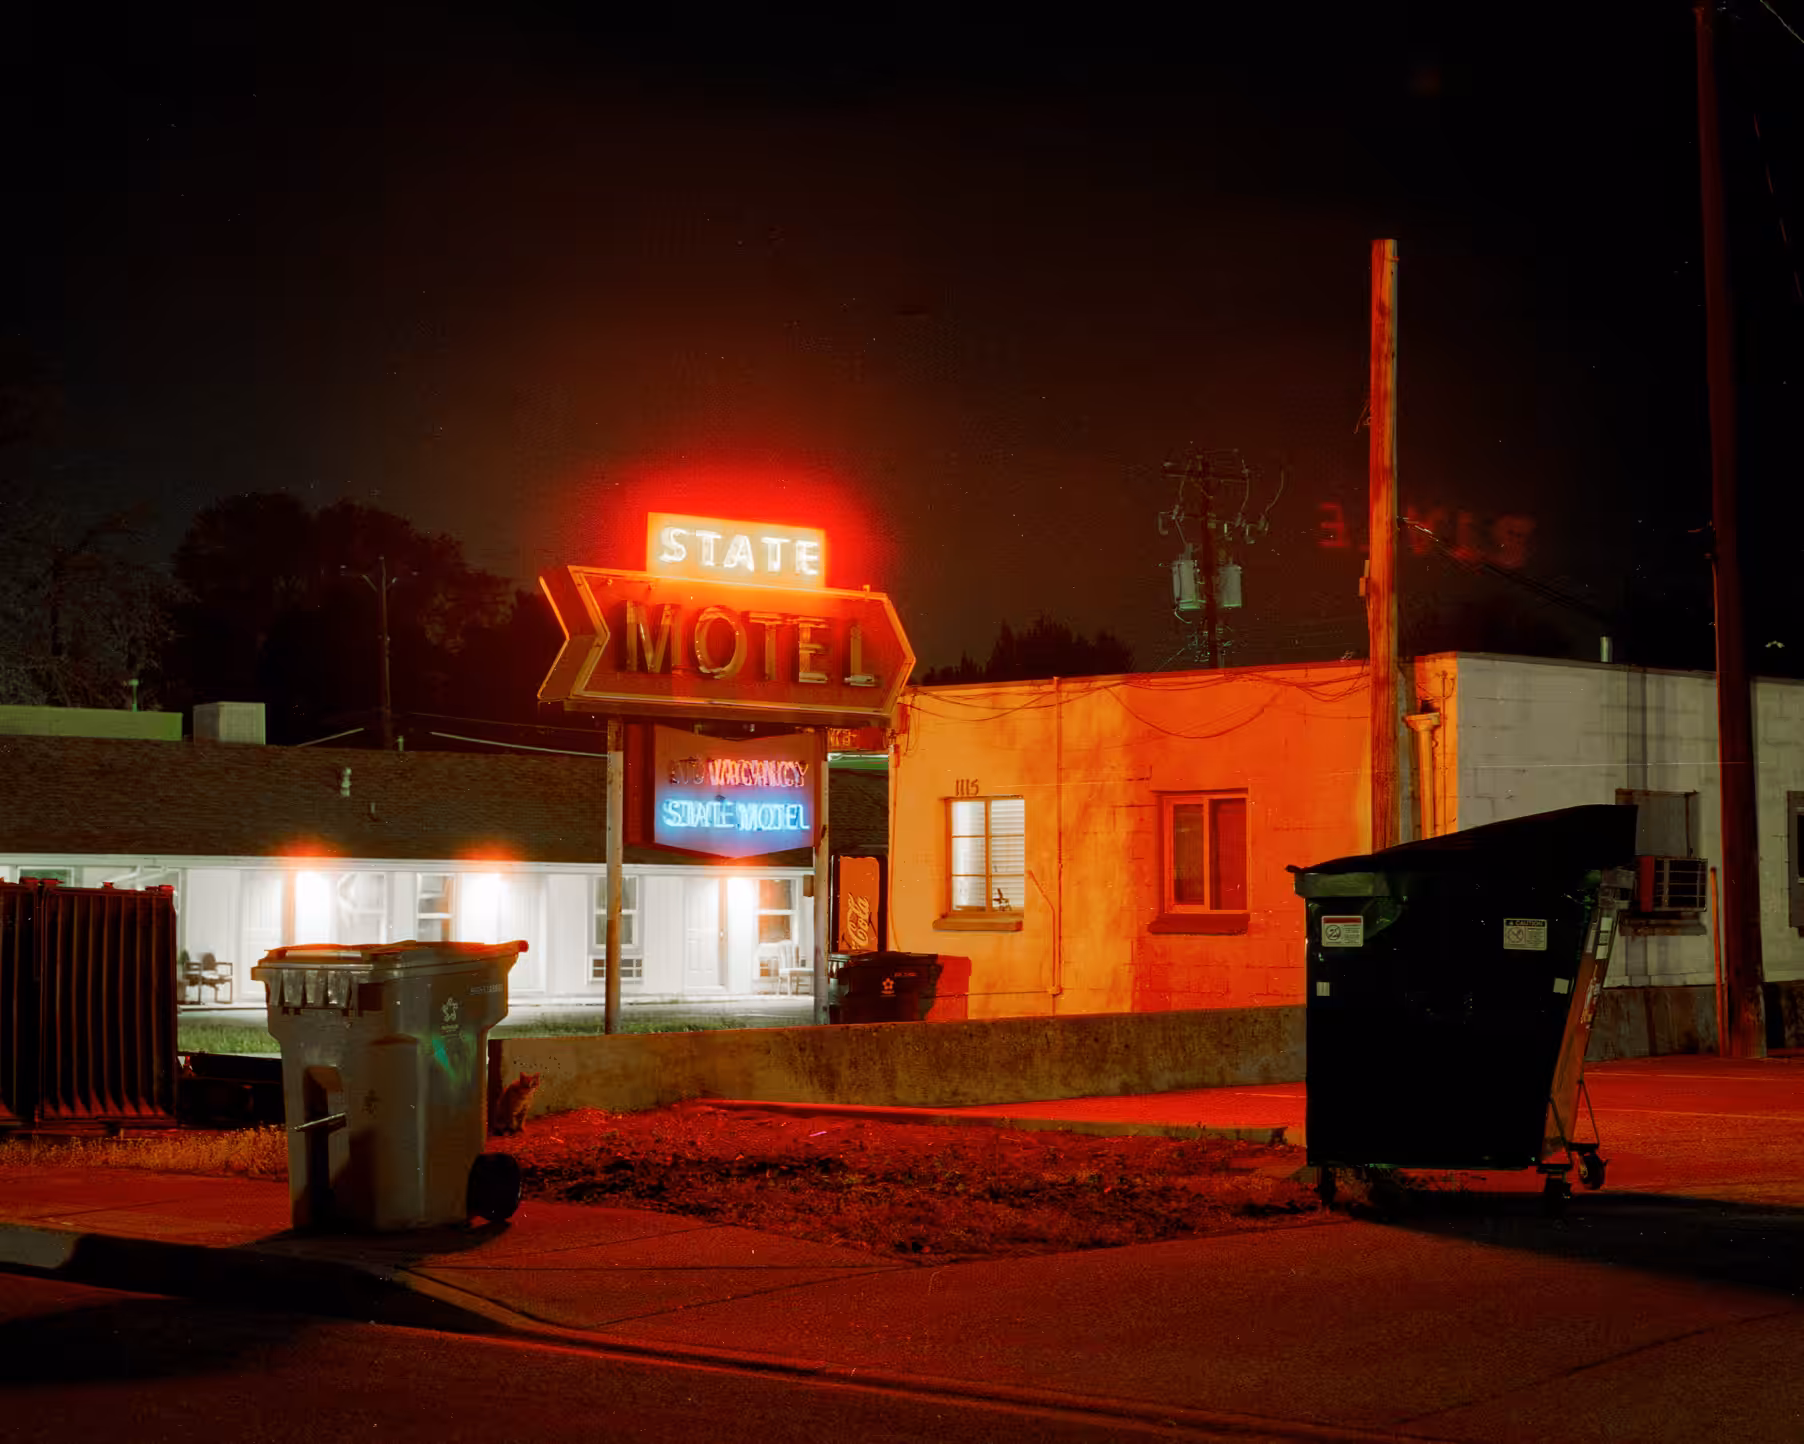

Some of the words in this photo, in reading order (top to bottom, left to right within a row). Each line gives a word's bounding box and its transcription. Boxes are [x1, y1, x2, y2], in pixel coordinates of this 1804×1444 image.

[658, 526, 819, 576] STATE
[626, 601, 876, 687] MOTEL
[708, 759, 809, 788] VACANCY
[955, 779, 979, 797] 1115
[662, 799, 736, 828] STATE
[736, 803, 811, 832] MOTEL
